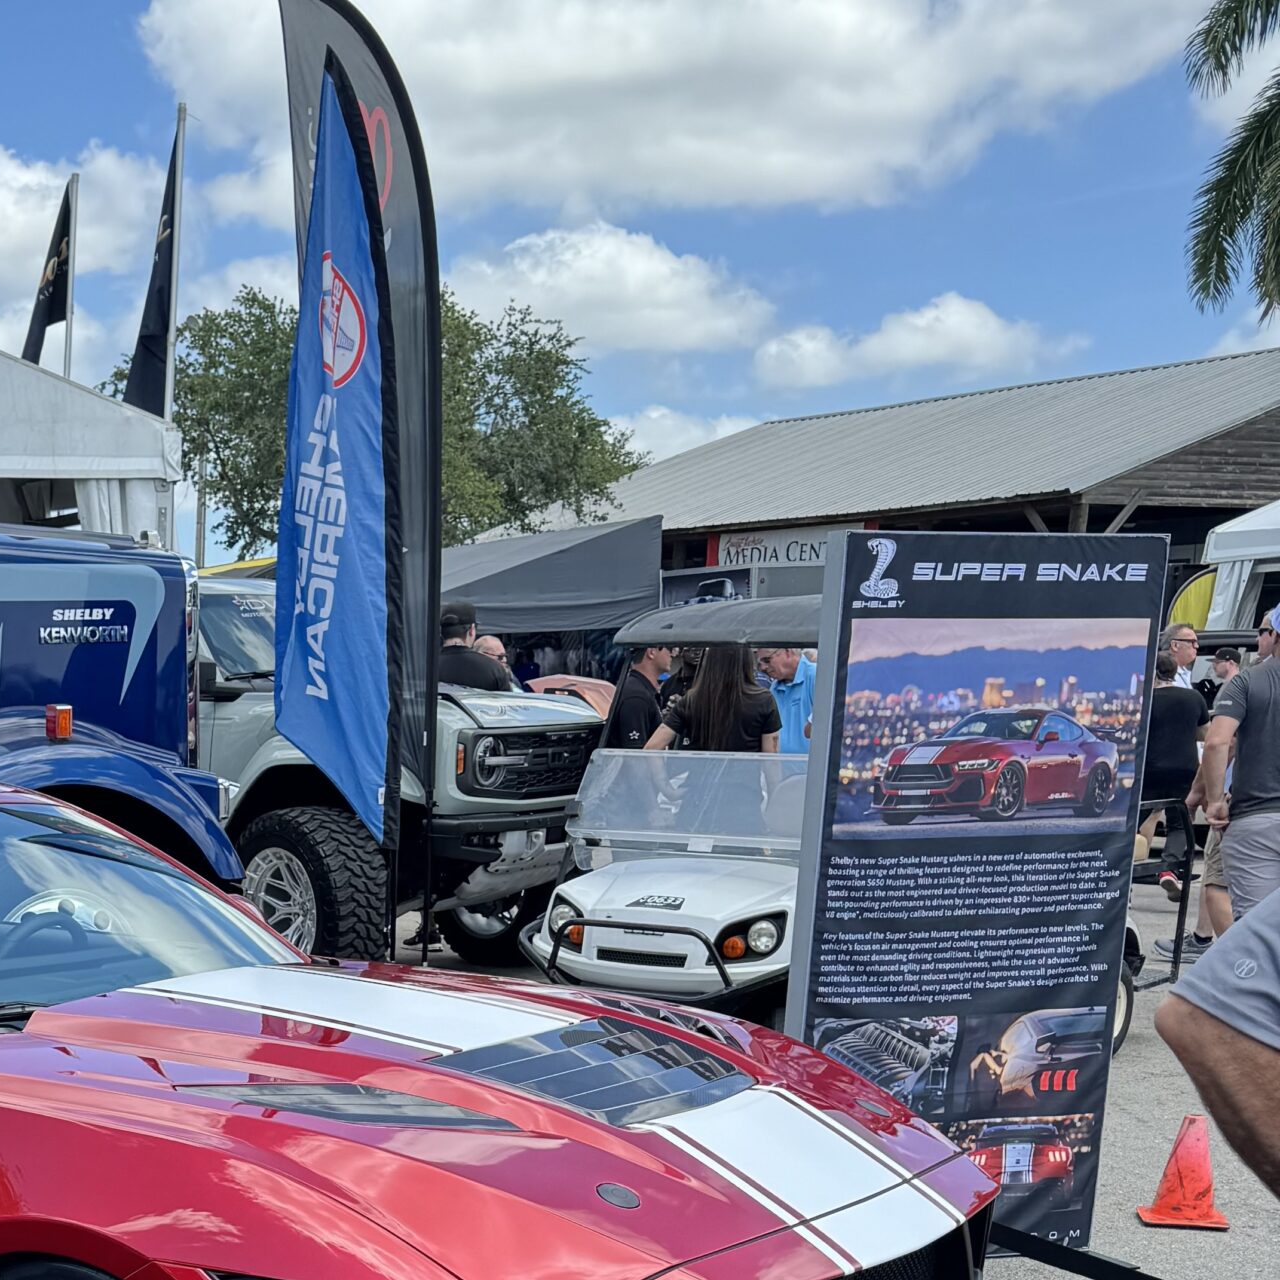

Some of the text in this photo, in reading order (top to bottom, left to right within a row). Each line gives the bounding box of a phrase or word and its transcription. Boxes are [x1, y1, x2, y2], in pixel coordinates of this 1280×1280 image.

[724, 546, 779, 565] MEDIA
[912, 563, 1149, 582] SUPER SNAKE
[851, 600, 906, 609] SHELBY
[52, 608, 114, 621] SHELBY
[39, 626, 128, 644] KENWORTH
[830, 856, 859, 867] Shelby's
[921, 854, 948, 865] Mustang
[949, 854, 972, 862] ushers
[1024, 851, 1065, 860] automotive
[829, 867, 859, 877] boasting
[897, 865, 923, 876] thrilling
[925, 864, 950, 873] features
[952, 863, 984, 874] designed
[995, 862, 1021, 871] redefine
[1023, 860, 1069, 872] performance
[827, 878, 865, 888] generation
[939, 875, 964, 885] striking
[966, 874, 992, 882] all-new
[1027, 872, 1057, 880] iteration
[906, 886, 942, 897] engineered
[958, 884, 1007, 893] driver-focused
[1009, 882, 1048, 893] production
[880, 897, 924, 908] performance
[932, 896, 953, 904] driven
[975, 894, 1011, 905] impressive
[1032, 891, 1069, 903] horsepower
[1071, 889, 1119, 901] supercharged
[863, 908, 908, 919] meticulously
[910, 907, 943, 916] calibrated
[953, 906, 976, 915] deliver
[979, 905, 1020, 916] exhilarating
[839, 931, 864, 939] features
[931, 928, 958, 939] Mustang
[960, 927, 985, 936] elevate
[998, 925, 1039, 936] performance
[1065, 923, 1089, 932] levels.
[892, 940, 937, 951] management
[953, 938, 978, 949] cooling
[1008, 936, 1033, 947] optimal
[1034, 934, 1080, 946] performance
[871, 950, 907, 961] demanding
[908, 950, 932, 960] driving
[934, 948, 972, 957] conditions.
[974, 946, 1013, 958] Lightweight
[1015, 945, 1055, 956] magnesium
[821, 955, 1079, 972] contribute enhanced agility responsiveness, advanced
[819, 973, 850, 982] materials
[879, 972, 903, 980] carbon
[921, 970, 946, 979] reduces
[948, 969, 970, 980] weight
[987, 968, 1018, 978] improves
[1020, 966, 1045, 975] overall
[857, 983, 887, 992] attention
[899, 982, 920, 992] detail,
[941, 981, 963, 991] aspect
[1008, 977, 1035, 986] Snake's
[1064, 974, 1088, 983] crafted
[816, 993, 972, 1004] maximize performance driving enjoyment.
